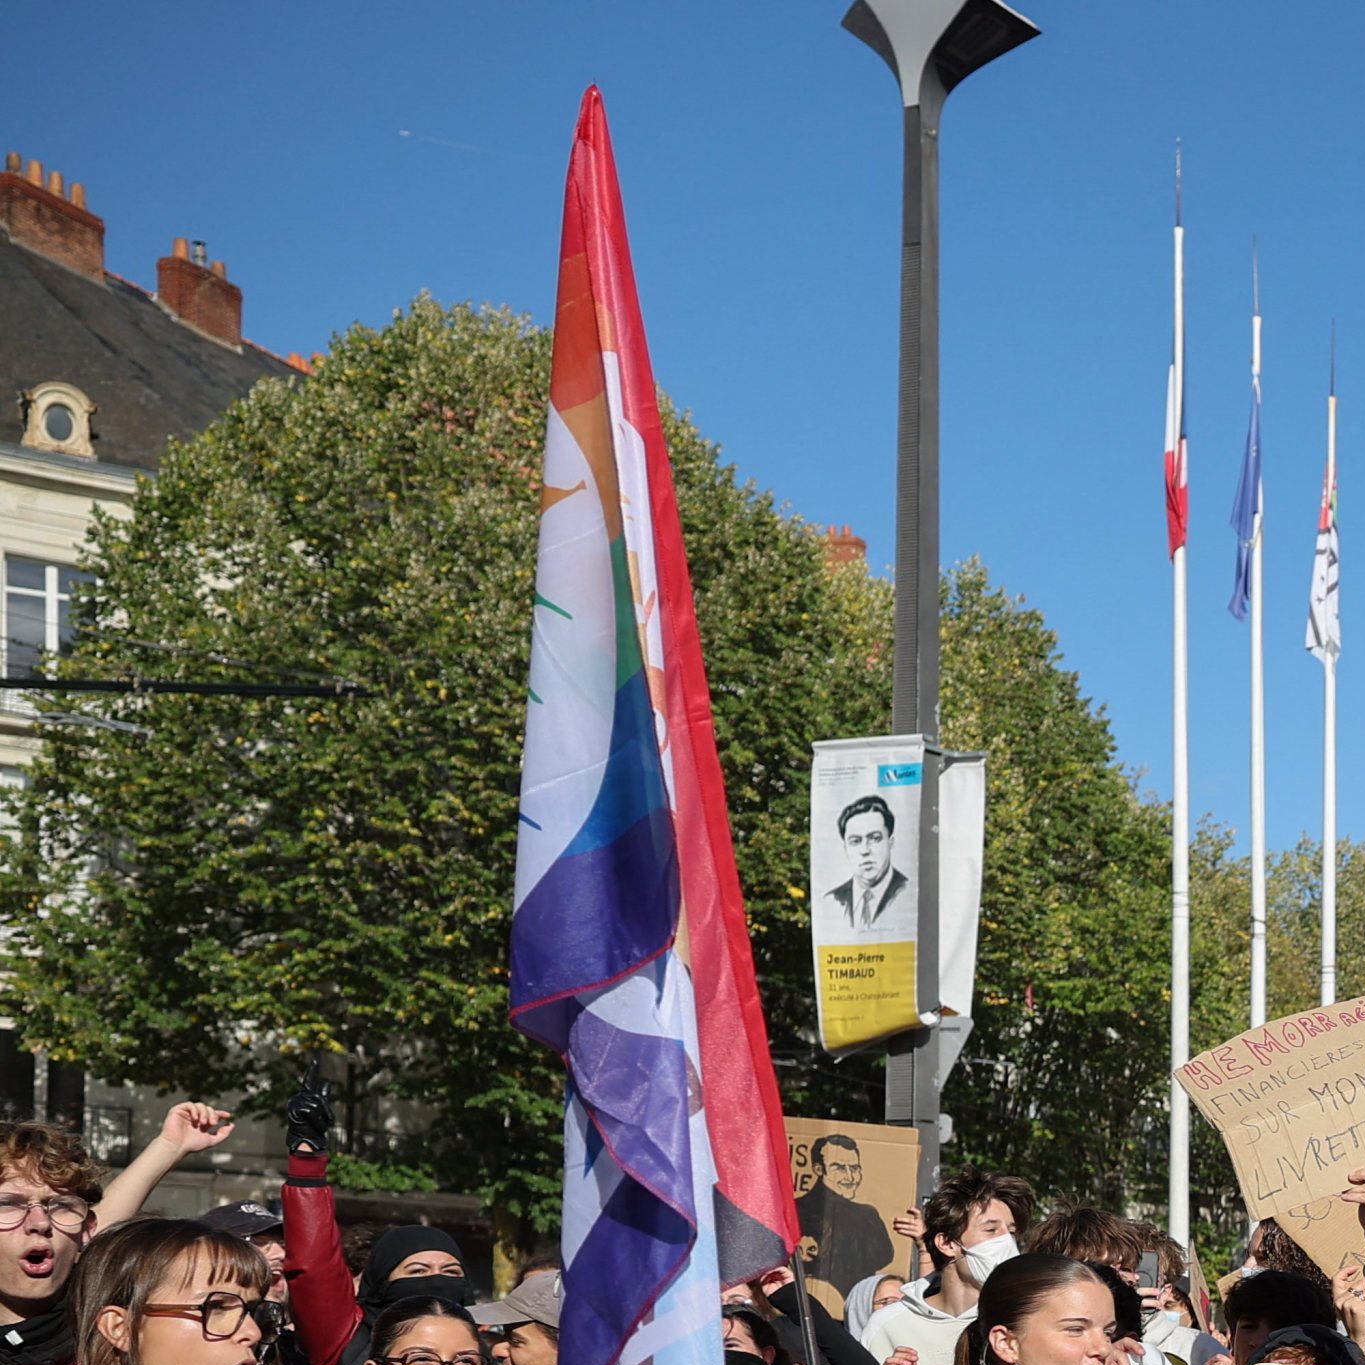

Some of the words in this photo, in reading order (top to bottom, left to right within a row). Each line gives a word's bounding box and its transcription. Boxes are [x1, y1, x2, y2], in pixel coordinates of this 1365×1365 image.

[827, 953, 885, 965] Jean-Pierre
[827, 968, 876, 979] TIMBAUD
[1211, 1039, 1364, 1115] FINANCIÈRES
[1240, 1101, 1301, 1145] SUR
